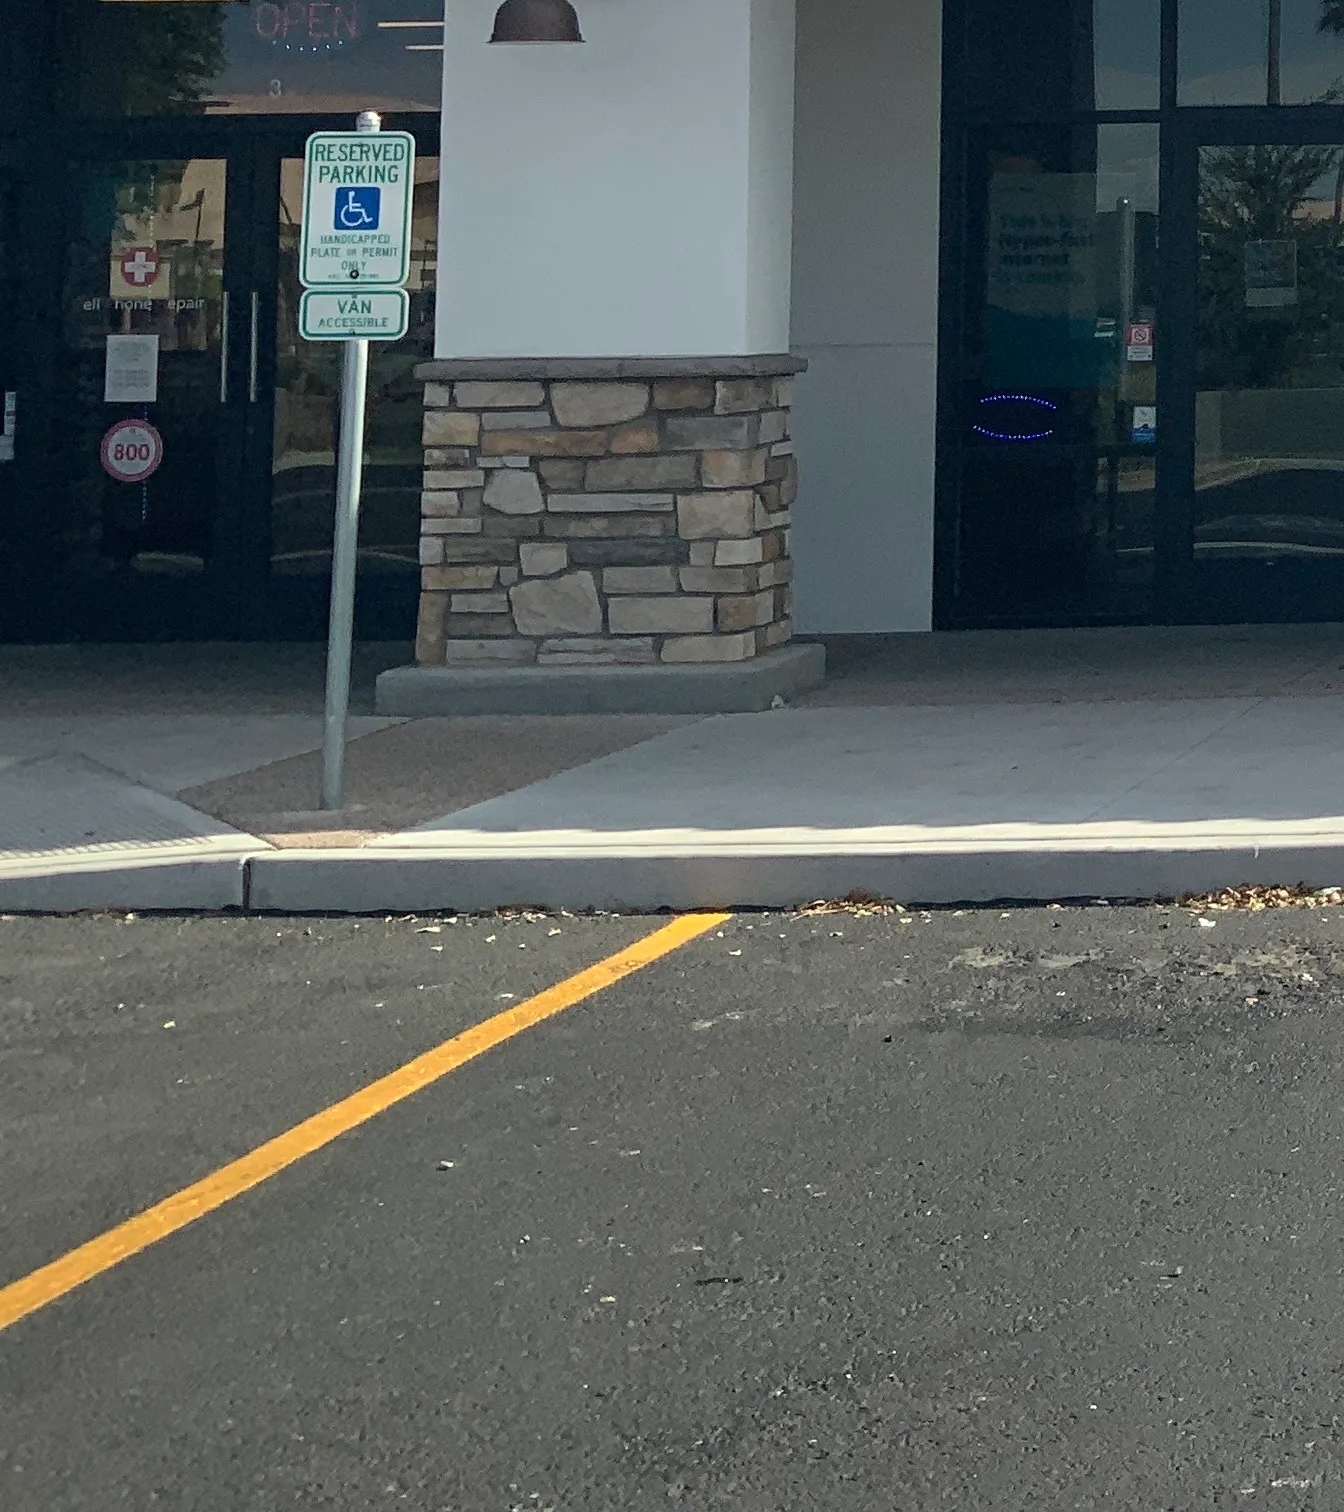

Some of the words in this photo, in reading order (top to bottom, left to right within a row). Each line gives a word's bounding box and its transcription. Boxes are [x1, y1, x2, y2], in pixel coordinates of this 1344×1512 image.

[255, 1, 361, 39] OPEN
[269, 78, 282, 99] 3
[315, 142, 405, 163] RESERVED
[318, 164, 400, 184] PARKING
[319, 233, 391, 245] HANDICAPPED
[310, 247, 341, 258] PLATE
[362, 247, 399, 258] PERMIT
[340, 260, 367, 271] ONLY
[336, 299, 373, 314] VAN
[317, 316, 391, 329] ACCESSIBLE
[113, 443, 151, 462] 800
